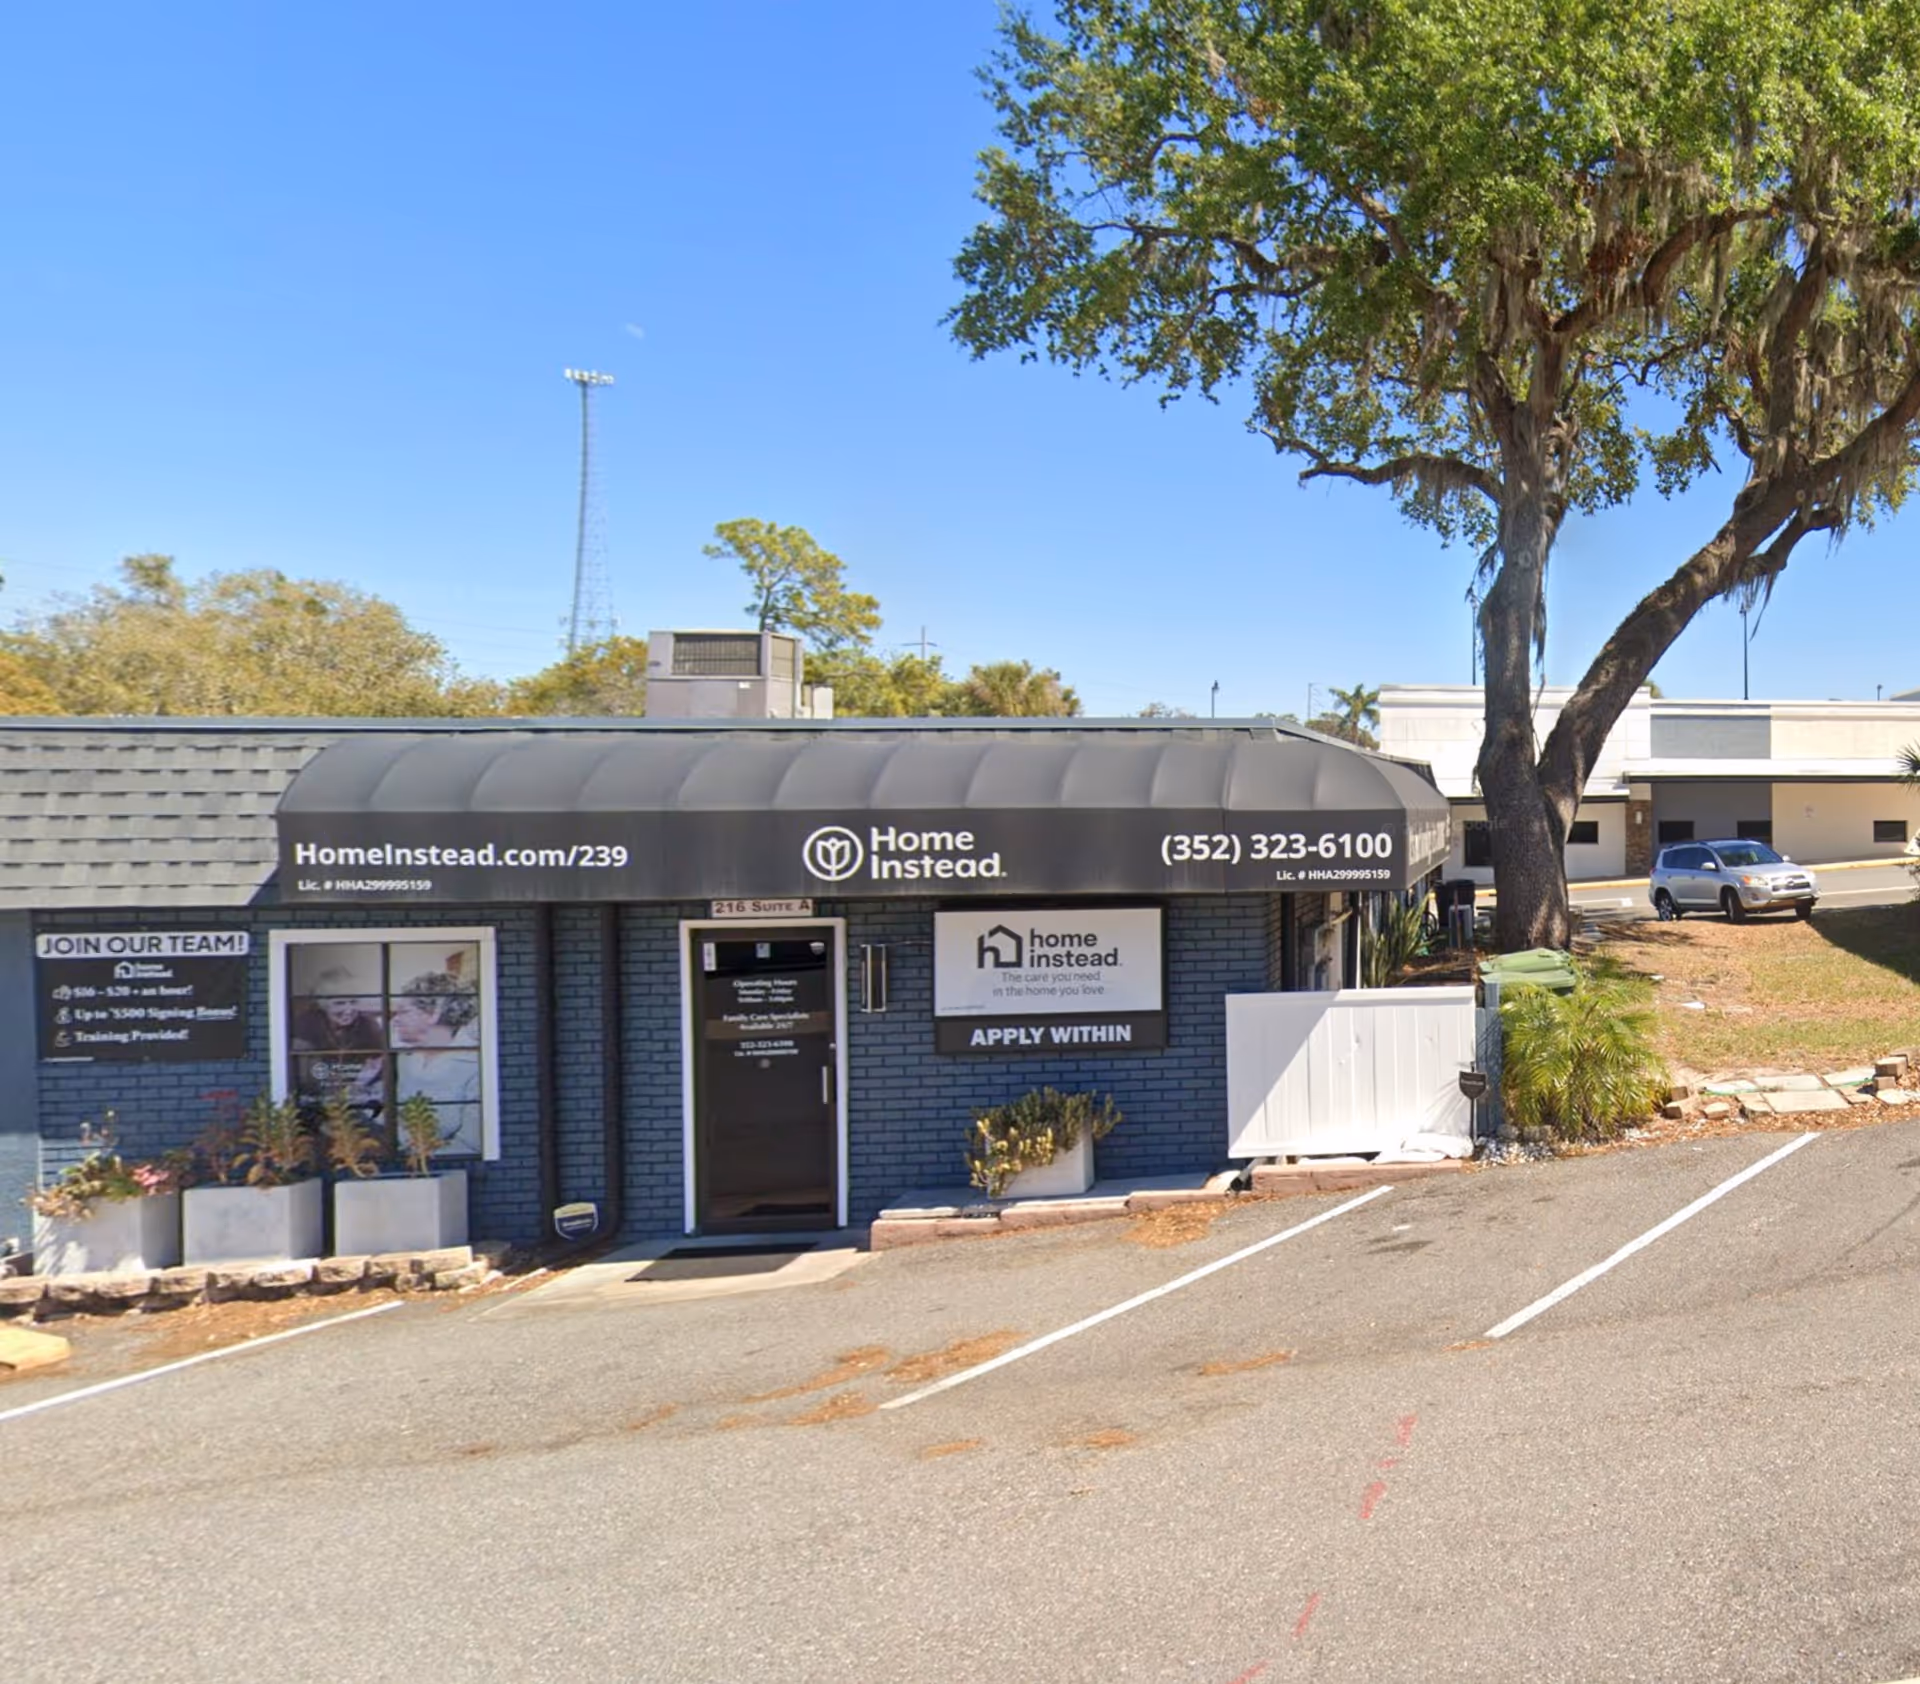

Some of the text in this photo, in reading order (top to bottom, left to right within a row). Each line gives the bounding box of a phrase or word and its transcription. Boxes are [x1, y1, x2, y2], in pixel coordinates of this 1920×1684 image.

[870, 826, 975, 852] Home
[1161, 833, 1242, 865] (352)
[1250, 832, 1392, 859] 323-6100
[295, 842, 628, 867] HomeInstead.com/239
[1276, 869, 1391, 880] Lic. # HHA299995159
[298, 879, 321, 891] Lic.
[715, 901, 746, 914] 216
[798, 899, 811, 911] A
[43, 935, 245, 954] JOIN OUR TEAM!
[1029, 928, 1098, 948] home
[1001, 971, 1101, 984] The care you need
[992, 984, 1105, 997] in the home you love
[970, 1025, 1132, 1046] APPLY WITHIN
